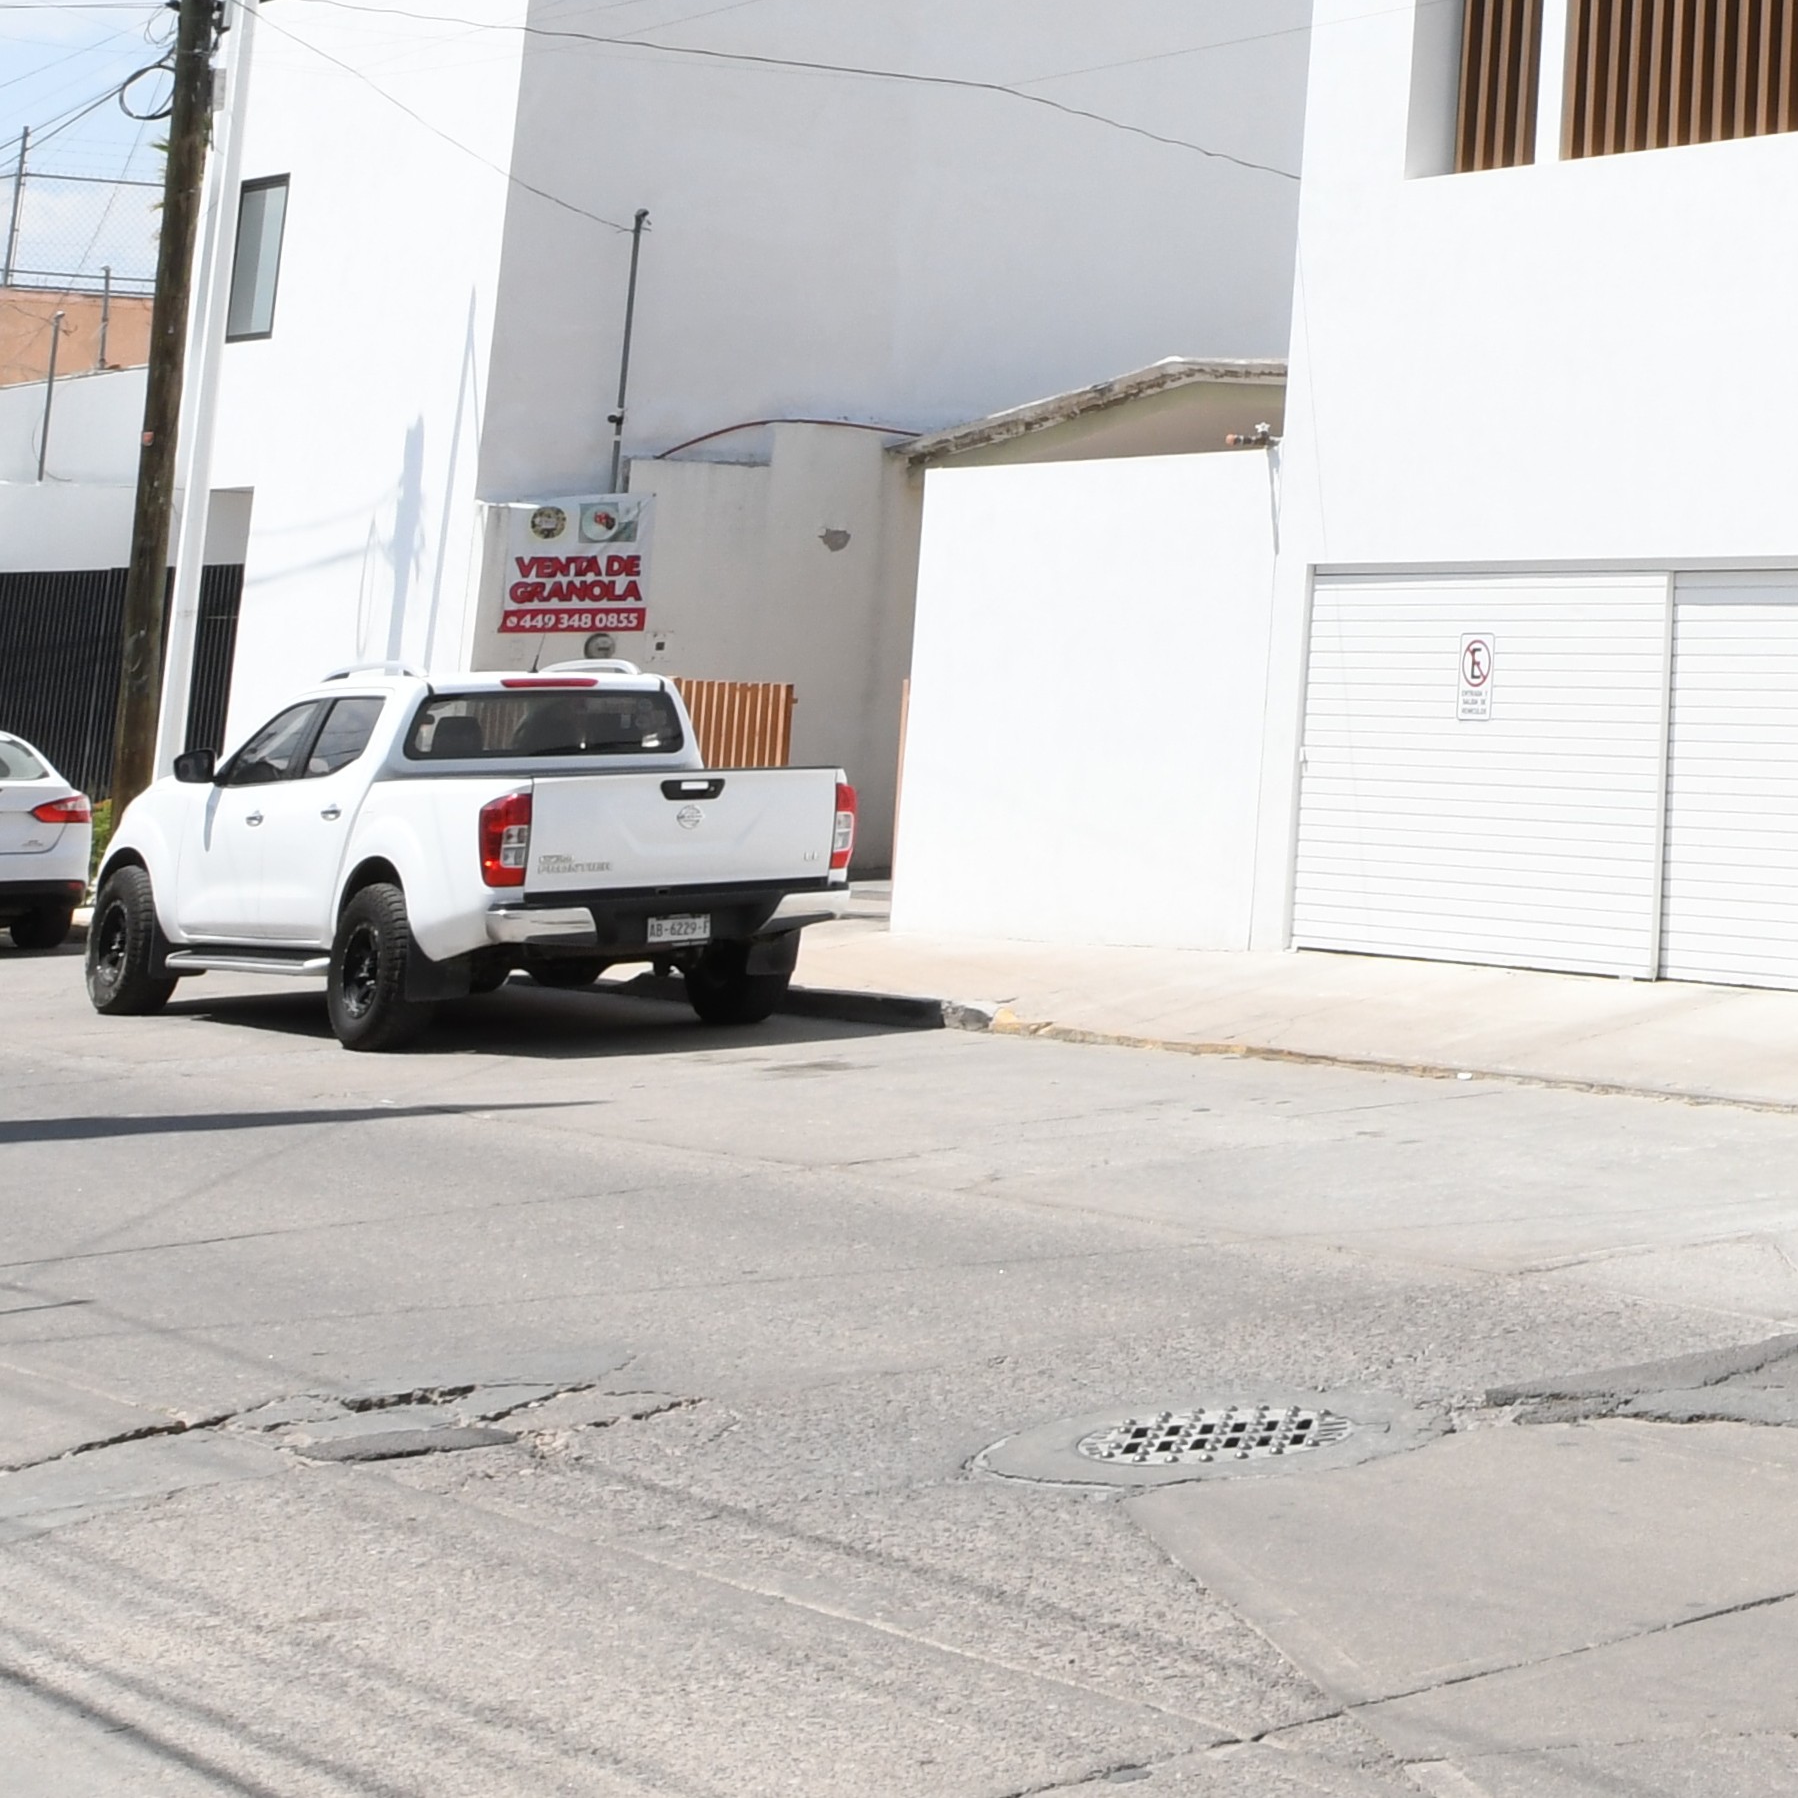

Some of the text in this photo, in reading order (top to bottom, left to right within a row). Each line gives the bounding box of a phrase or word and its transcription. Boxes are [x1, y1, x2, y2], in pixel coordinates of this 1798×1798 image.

[515, 555, 642, 578] VENTA DE
[509, 580, 642, 604] GRANOLA
[519, 613, 638, 628] 449 348 0855
